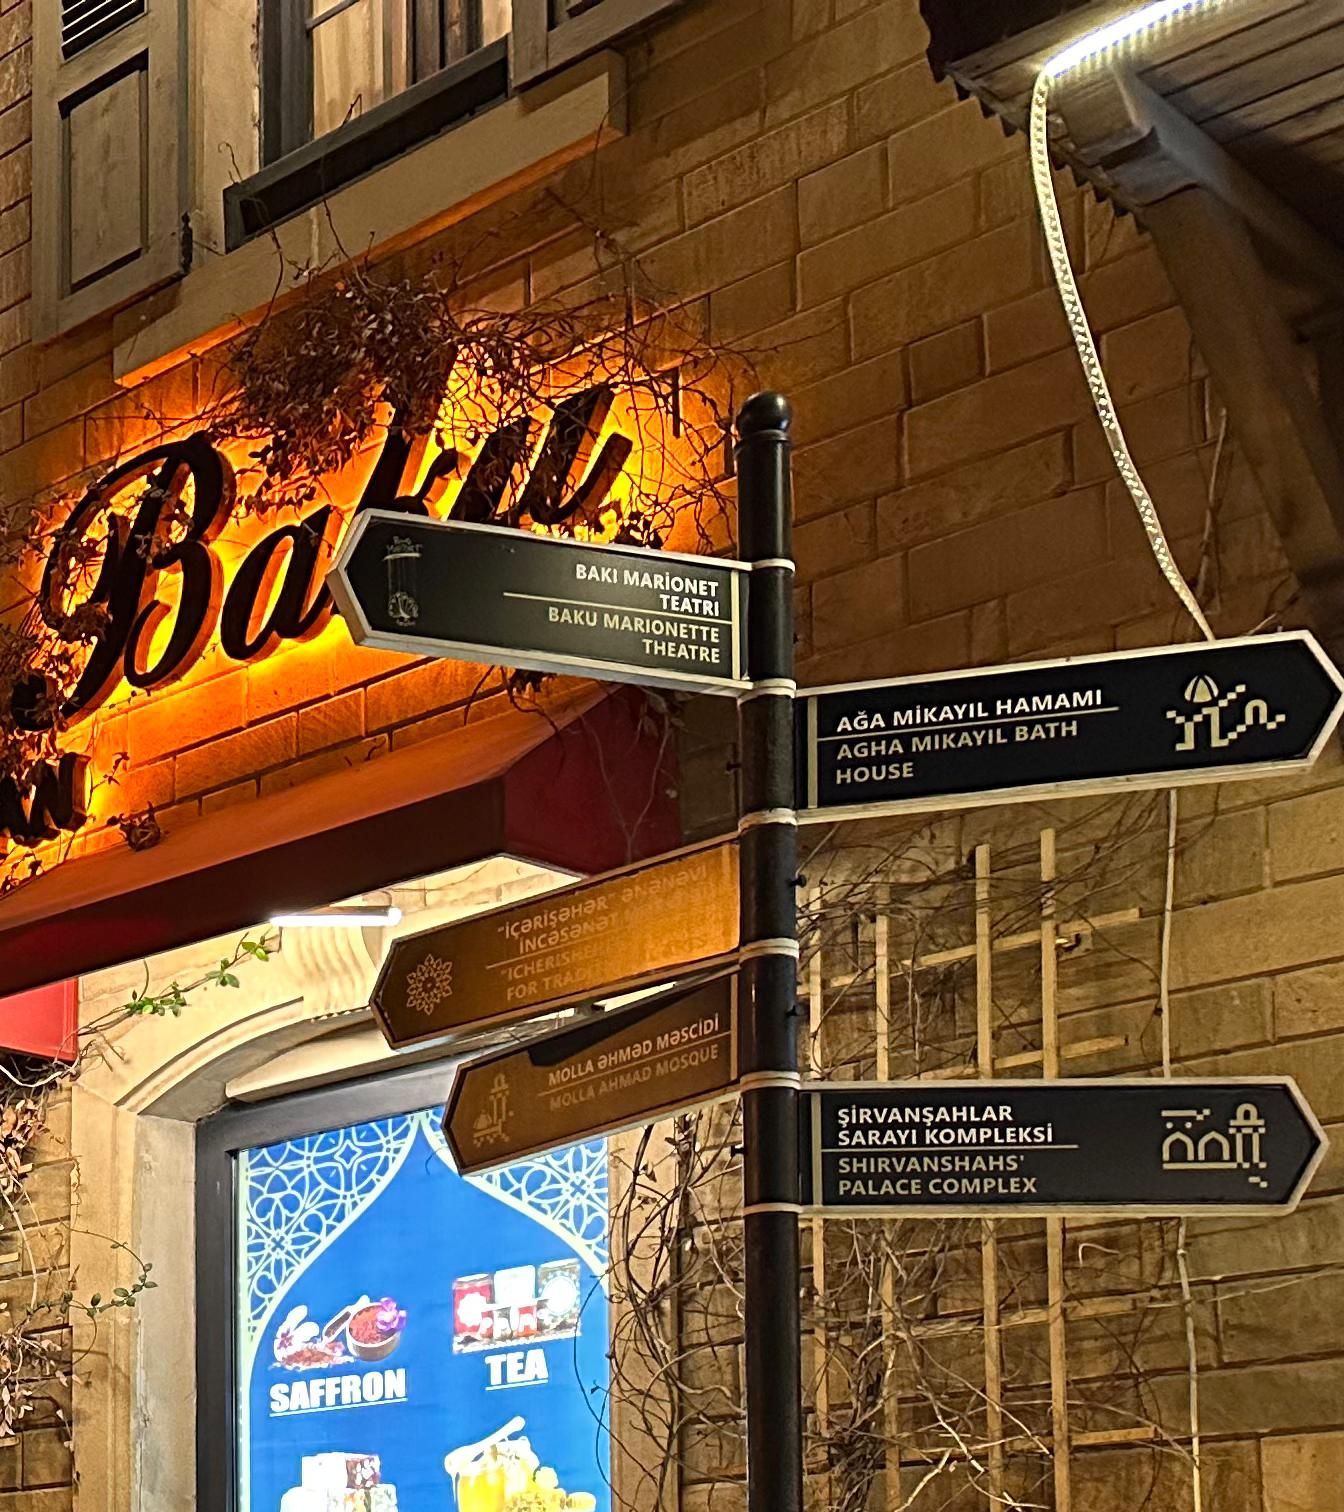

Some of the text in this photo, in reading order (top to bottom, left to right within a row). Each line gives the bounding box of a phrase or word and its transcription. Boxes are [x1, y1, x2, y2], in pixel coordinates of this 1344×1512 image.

[575, 563, 720, 597] BAKI MARİONET
[659, 593, 720, 617] TEATRI
[548, 606, 720, 643] BAKU MARIONETTE
[642, 638, 720, 664] THEATRE
[836, 688, 1102, 733] AĞA MİKAYIL HAMAMI
[836, 720, 1078, 761] AGHA MIKAYIL BATH
[835, 761, 915, 785] HOUSE
[549, 1060, 594, 1087] MOLLA
[597, 1039, 653, 1071] ƏHMƏD
[551, 1044, 719, 1110] MOLLA AHMAD MOSQUE
[837, 1104, 1013, 1127] ŞİRVANŞAHLAR
[837, 1122, 1054, 1147] SARAYI KOMPLEKSİ
[838, 1175, 1038, 1197] PALACE COMPLEX
[269, 1349, 550, 1413] SAFFRON TEA
